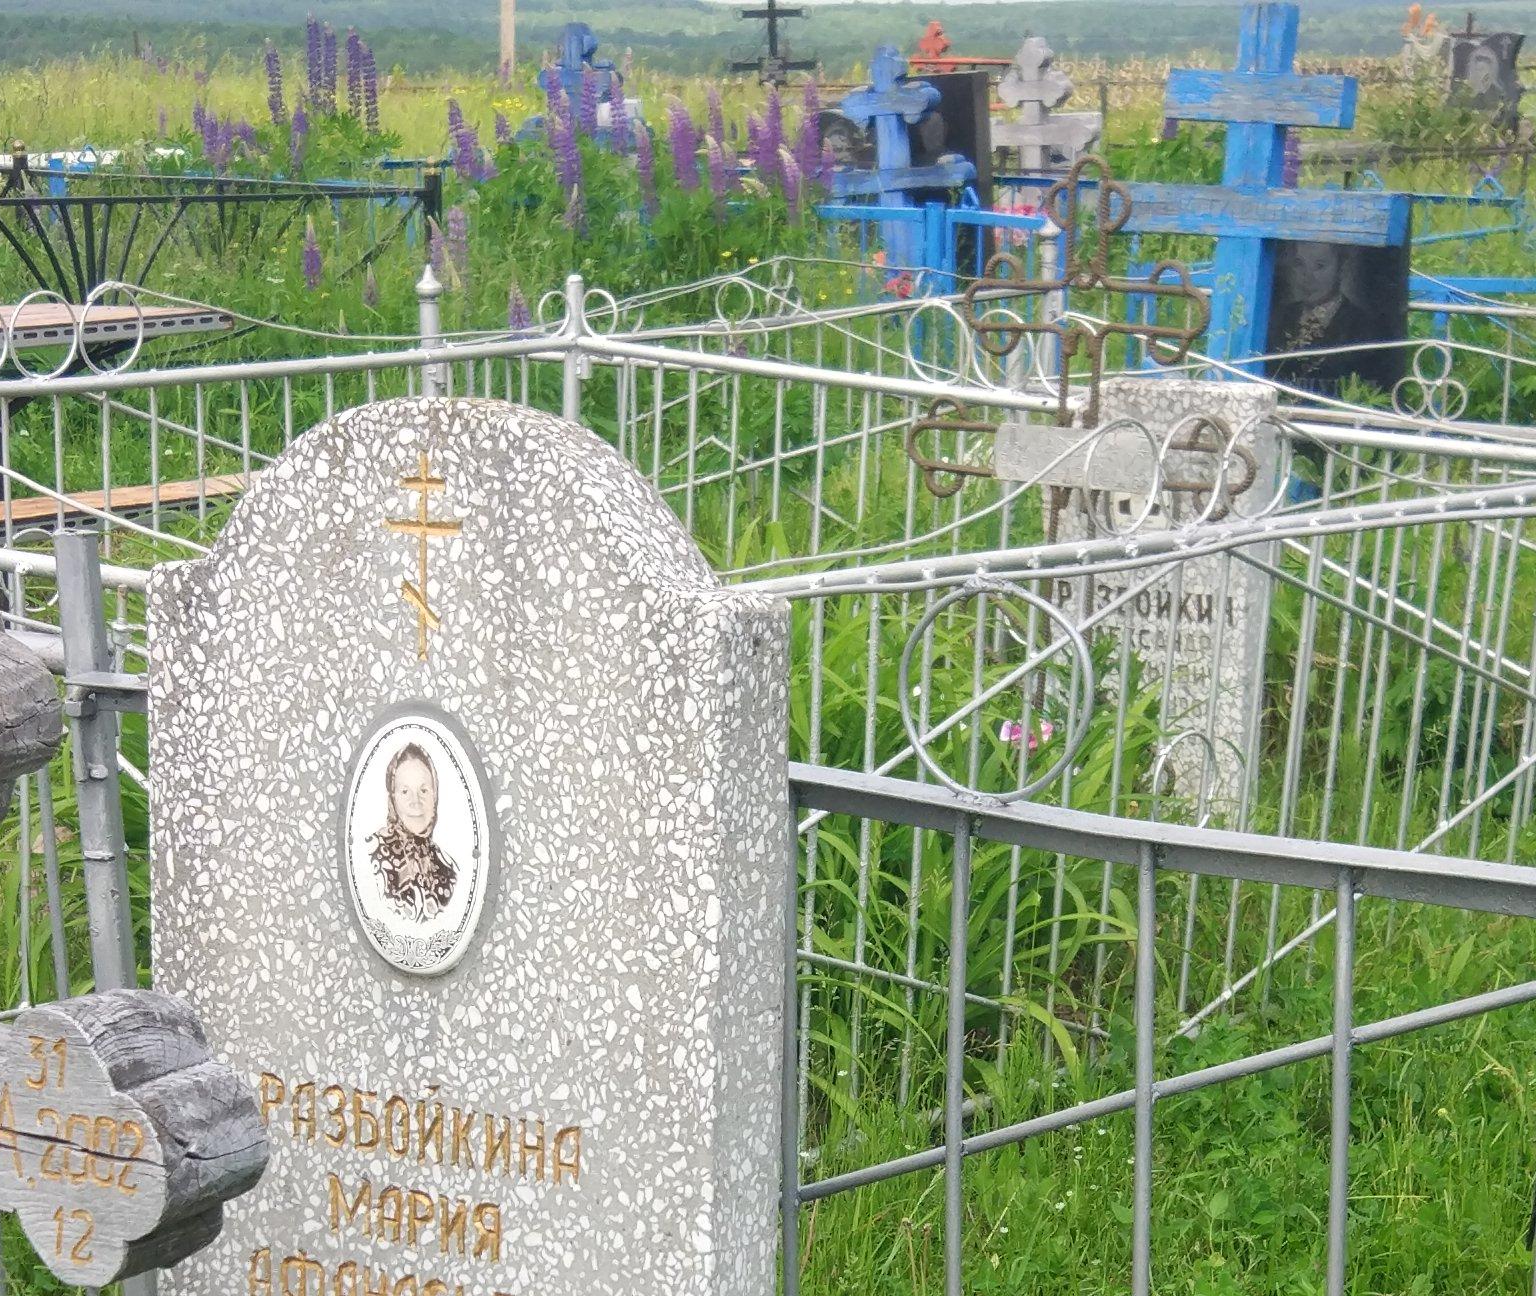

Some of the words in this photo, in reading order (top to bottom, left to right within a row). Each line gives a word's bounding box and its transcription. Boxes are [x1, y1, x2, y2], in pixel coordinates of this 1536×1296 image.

[26, 1035, 66, 1091] 31
[36, 1107, 146, 1195] 2002
[260, 1071, 582, 1188] РАЗБОЙКИНА
[52, 1205, 95, 1265] 12
[328, 1171, 502, 1263] МАРИЯ
